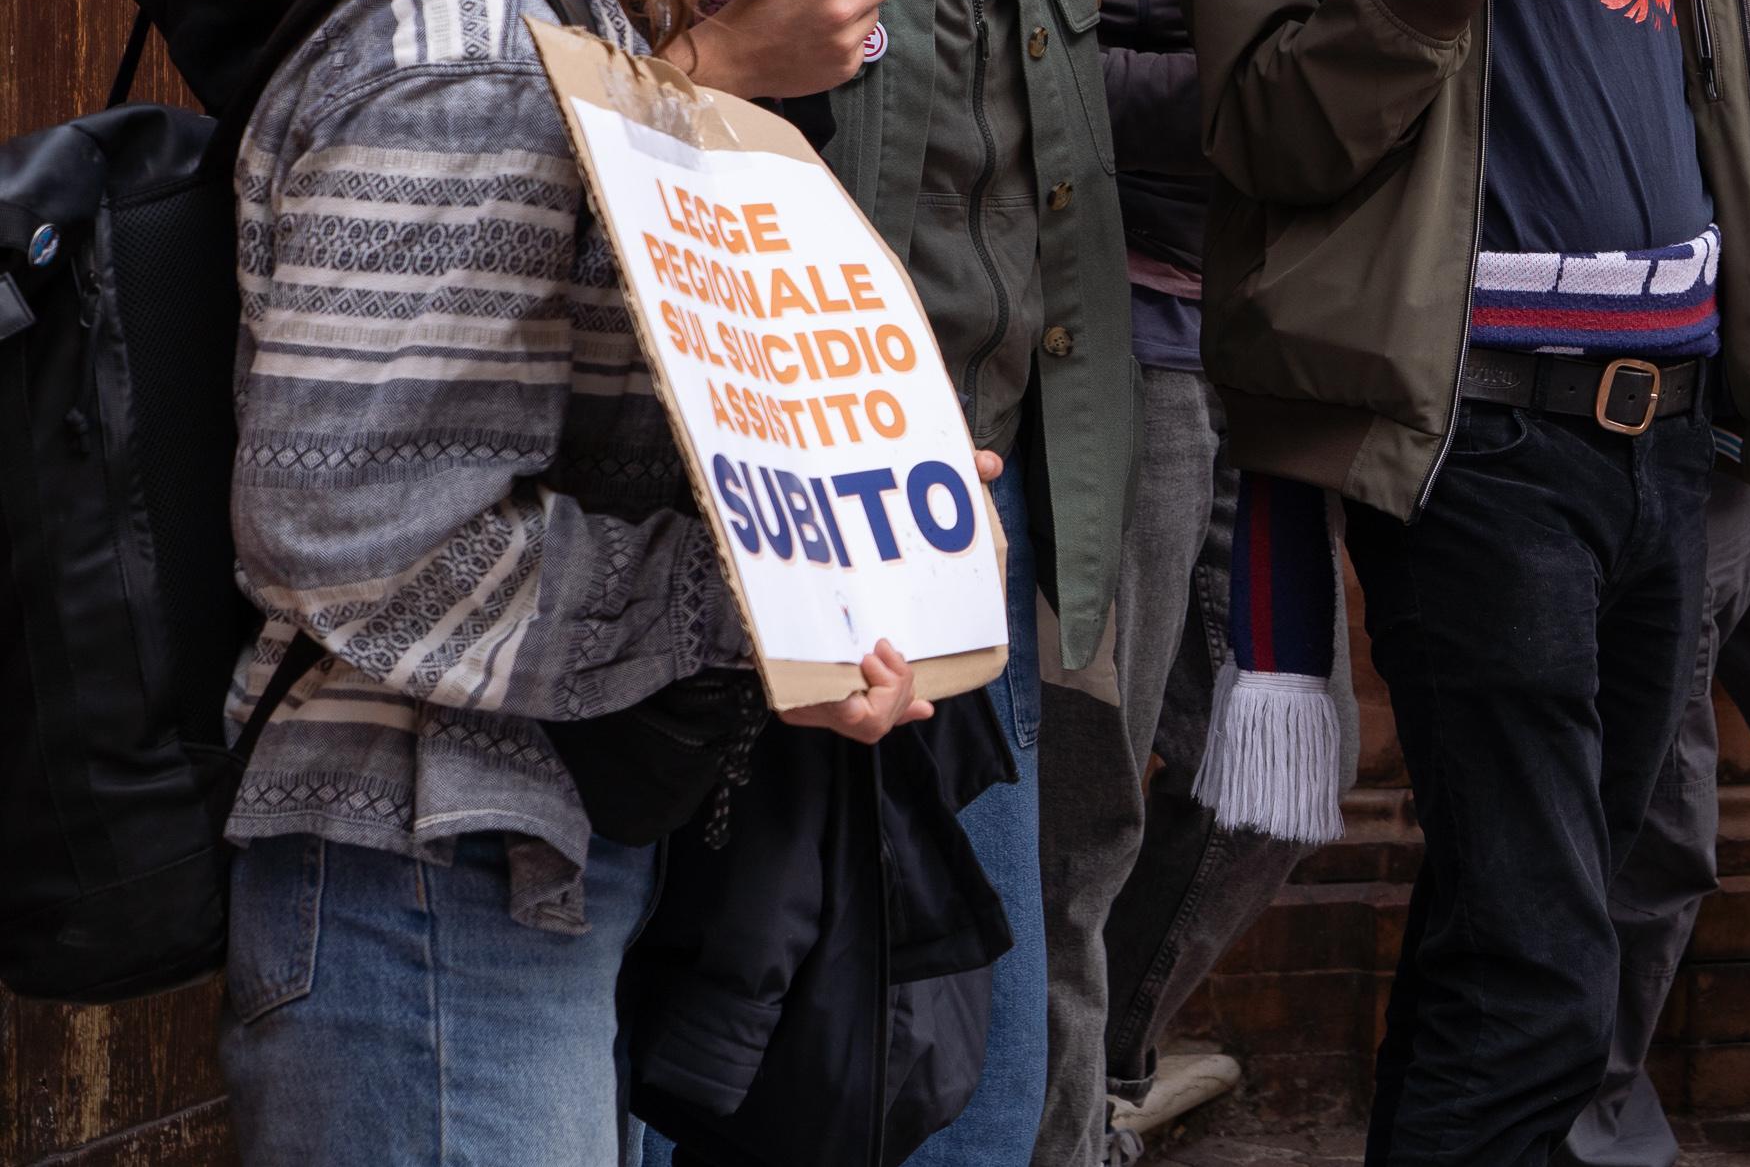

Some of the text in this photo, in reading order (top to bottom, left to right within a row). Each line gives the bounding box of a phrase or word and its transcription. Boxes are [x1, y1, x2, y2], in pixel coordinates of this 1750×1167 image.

[656, 178, 790, 254] LEGGE
[643, 233, 885, 319] REGIONALE
[660, 301, 916, 385] SUL SUICIDIO
[707, 379, 906, 449] ASSISTITO
[713, 454, 975, 567] SUBITO
